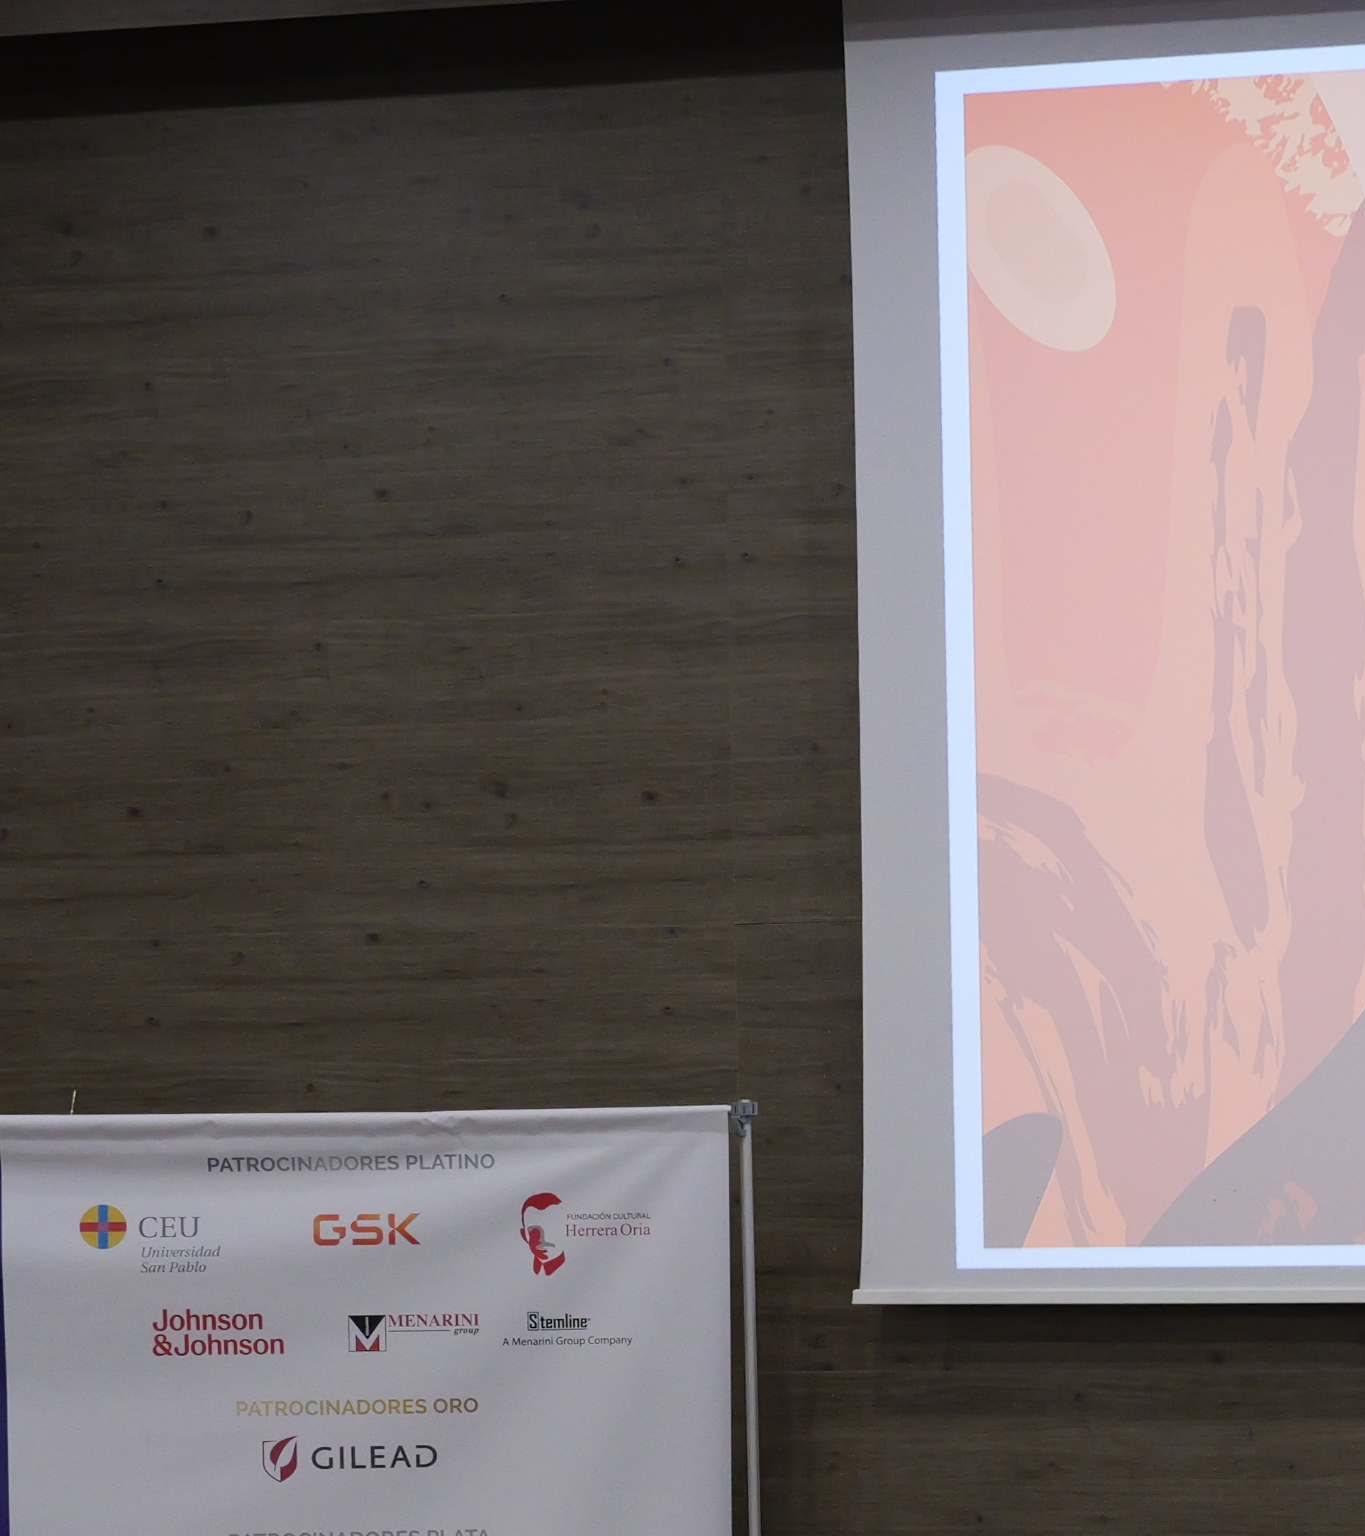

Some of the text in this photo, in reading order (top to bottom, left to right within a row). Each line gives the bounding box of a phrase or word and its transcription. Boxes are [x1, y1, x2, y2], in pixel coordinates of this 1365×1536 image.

[207, 1152, 496, 1173] PATROCINADORES PLATINO
[567, 1211, 651, 1221] FUNDACIÓN CULTURAL
[138, 1216, 200, 1239] CEU
[313, 1213, 421, 1247] GSK
[565, 1222, 651, 1237] Herrera Oria
[141, 1245, 221, 1259] Universidad
[140, 1260, 207, 1274] San Pablo
[152, 1308, 264, 1332] Johnson
[388, 1313, 479, 1327] MENARINI
[528, 1313, 587, 1330] Stemline
[453, 1327, 480, 1336] group
[152, 1332, 285, 1357] &Johnson
[502, 1335, 633, 1348] A Menarini Group Company
[236, 1397, 479, 1416] PATROCINADORES ORO
[311, 1444, 438, 1470] GILEAD
